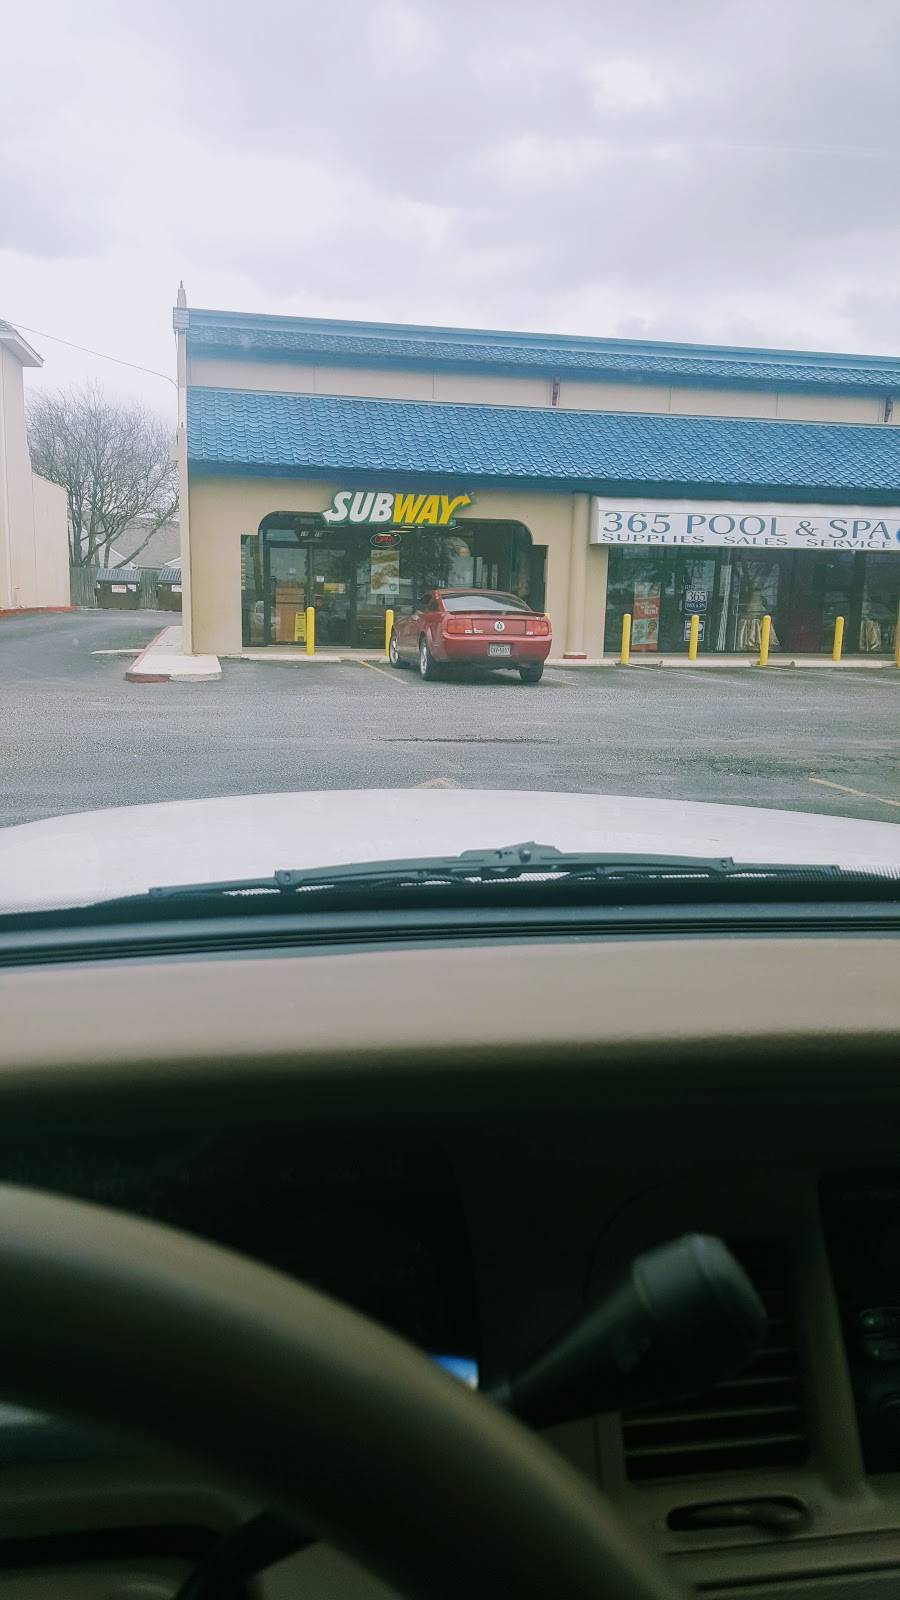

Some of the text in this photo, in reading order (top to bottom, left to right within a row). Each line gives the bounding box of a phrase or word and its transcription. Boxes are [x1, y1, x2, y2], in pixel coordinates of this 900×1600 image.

[322, 491, 472, 525] SUBWAY
[602, 512, 891, 540] 365 POOL & SPA
[601, 533, 891, 549] SUPPLIES SALES SERVICE
[686, 591, 706, 601] 365
